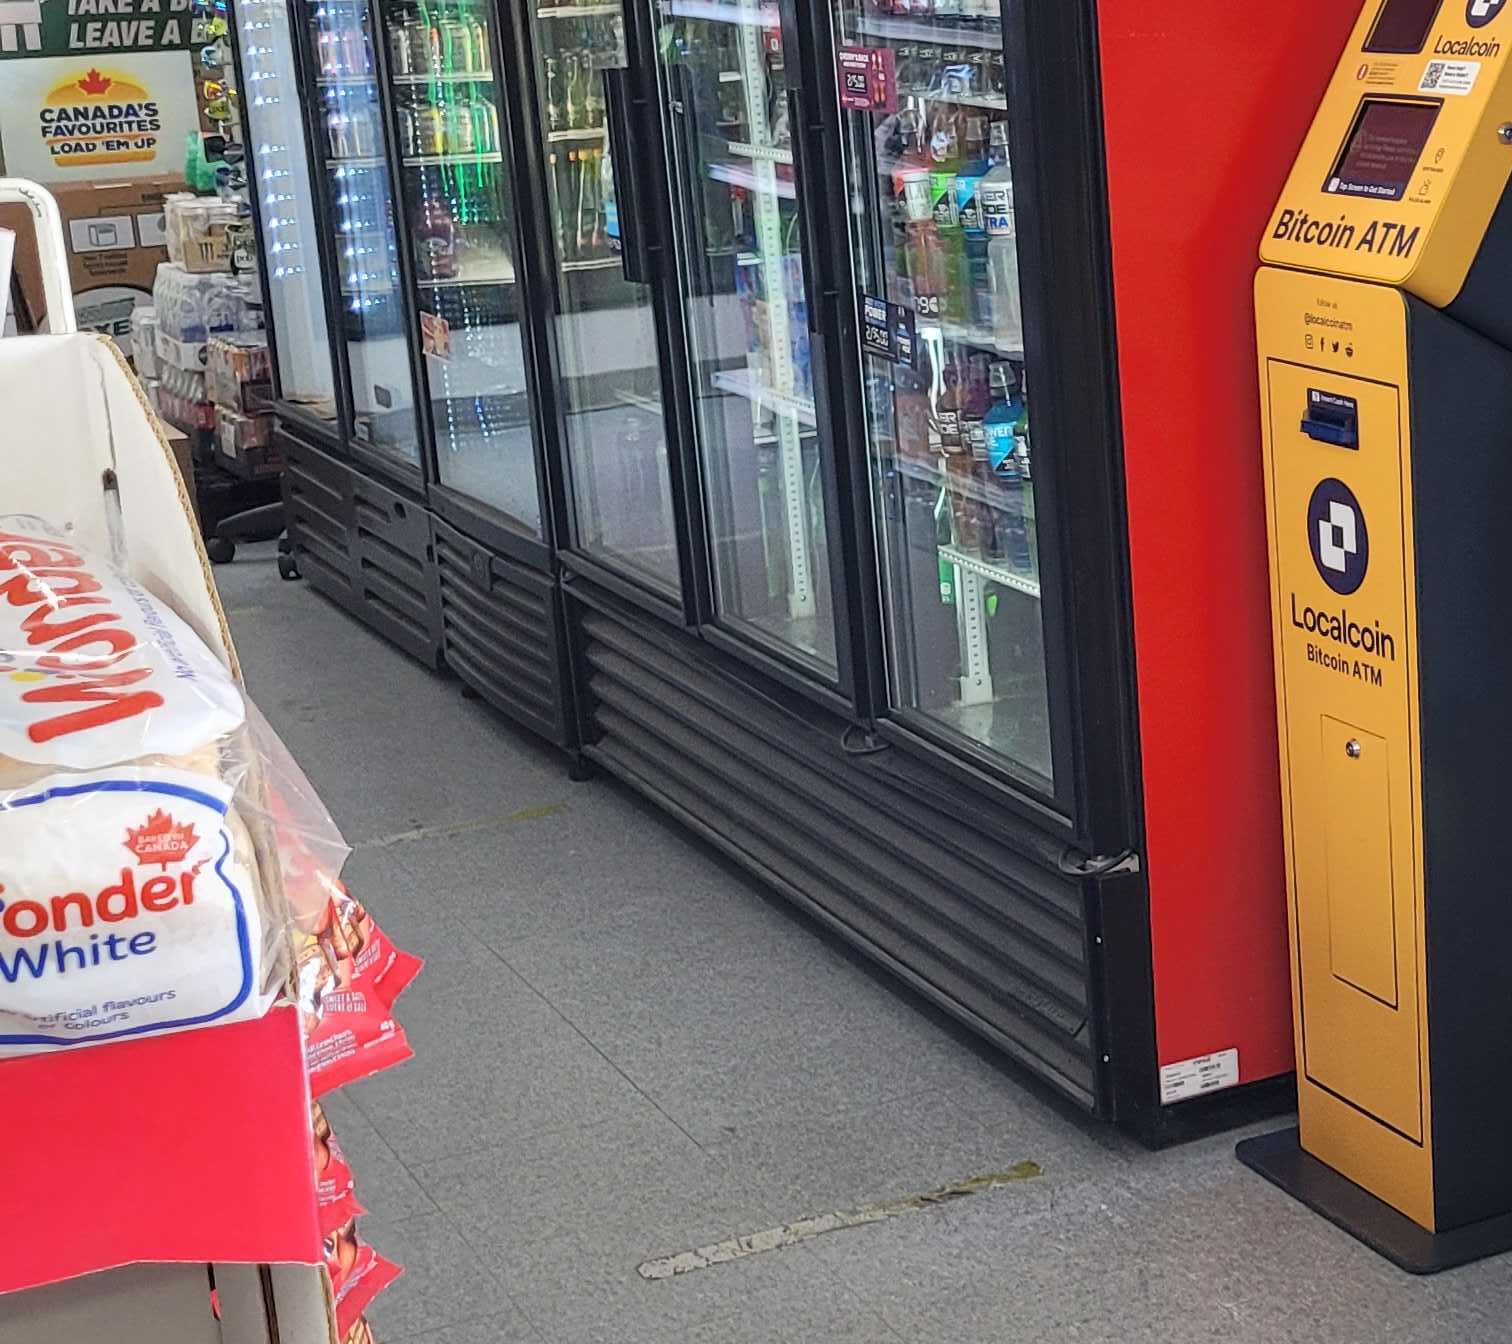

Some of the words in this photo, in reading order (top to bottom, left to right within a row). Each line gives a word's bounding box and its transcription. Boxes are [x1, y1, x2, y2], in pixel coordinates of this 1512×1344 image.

[69, 20, 154, 48] LEAVE
[161, 19, 181, 45] A
[1434, 35, 1500, 58] Localcoin
[40, 102, 159, 123] CANADA'S
[41, 118, 161, 138] FAVOURITES
[50, 142, 97, 155] LOAD
[102, 141, 130, 151] 'EM
[135, 138, 156, 149] UP
[1272, 208, 1355, 250] Bitcoin
[1356, 220, 1420, 258] ATM
[1291, 592, 1396, 661] Localcoin
[1307, 643, 1350, 676] Bitcoin
[1352, 658, 1383, 688] ATM
[134, 840, 189, 855] CANADA
[0, 858, 211, 939] onder
[0, 928, 157, 984] White
[103, 985, 176, 1015] flavours
[64, 1009, 130, 1032] colours
